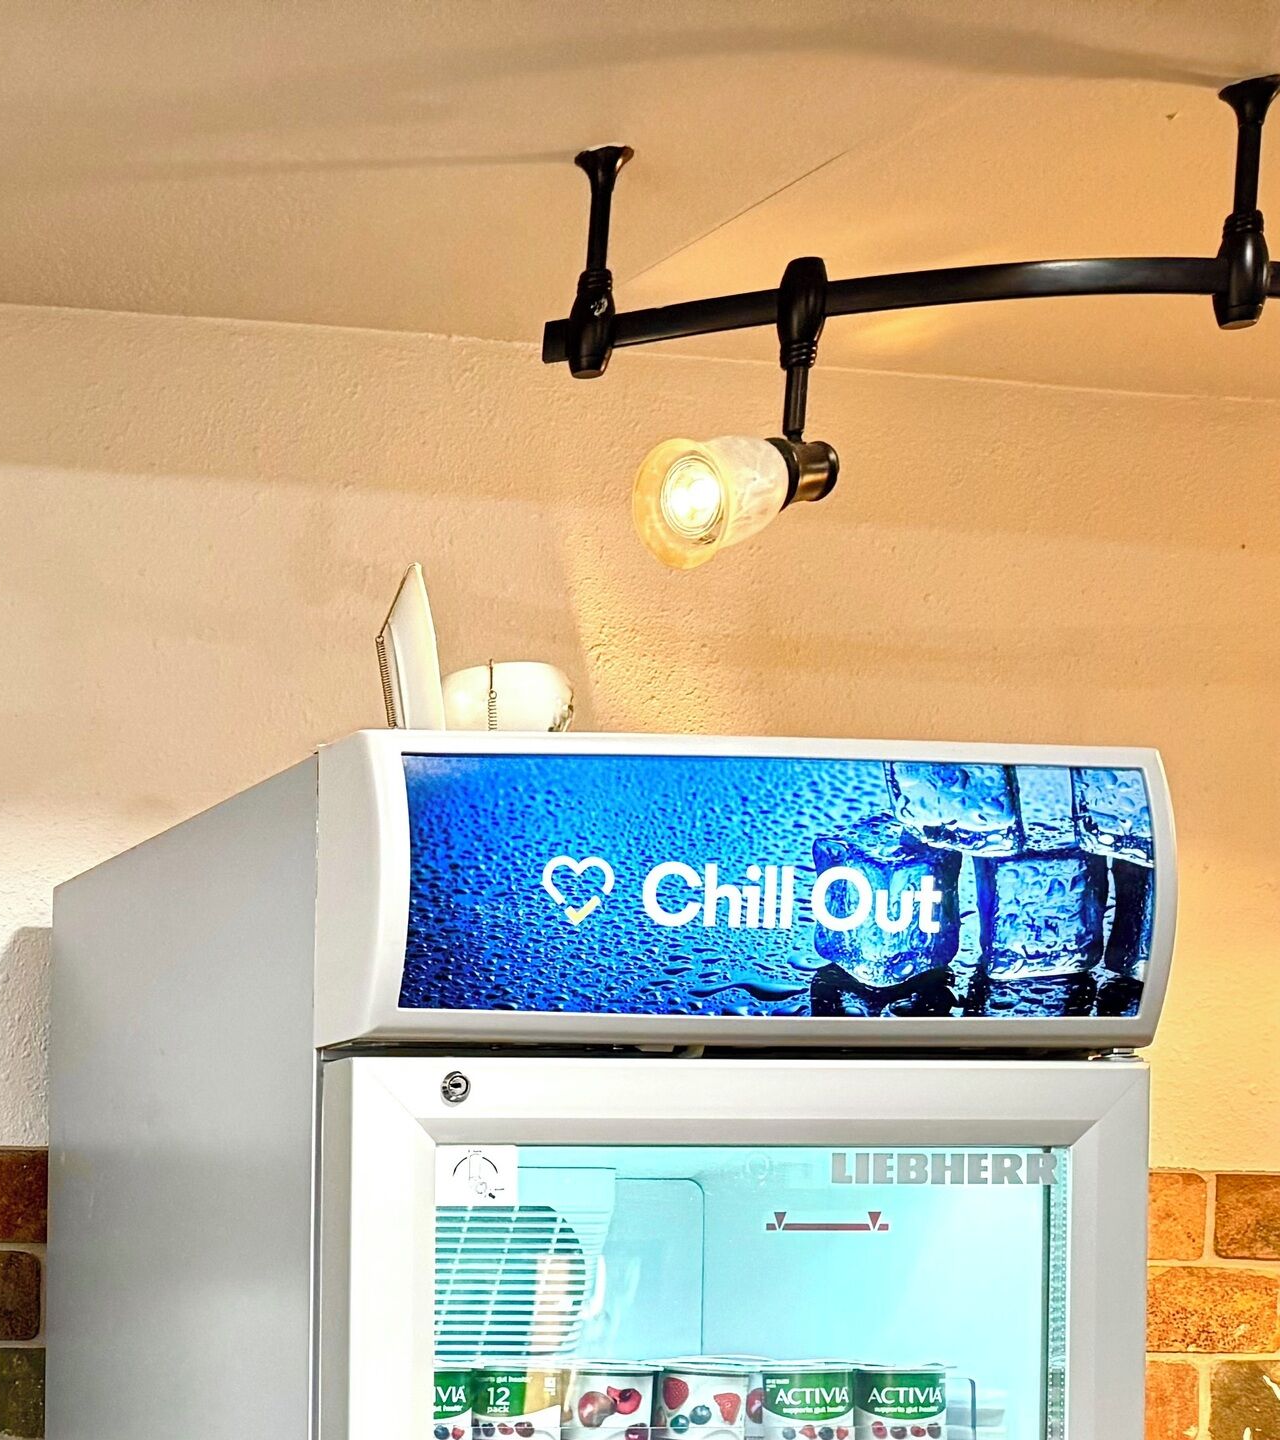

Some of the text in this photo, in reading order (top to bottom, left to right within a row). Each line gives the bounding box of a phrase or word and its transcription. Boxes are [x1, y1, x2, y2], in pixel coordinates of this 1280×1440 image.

[641, 861, 941, 934] Chill Out
[831, 1152, 1059, 1185] LIEBHERR
[434, 1385, 467, 1403] IVIA
[487, 1387, 510, 1406] 12
[775, 1386, 850, 1405] ACTIVIA
[867, 1386, 943, 1404] ACTIVIA
[486, 1405, 510, 1414] pack
